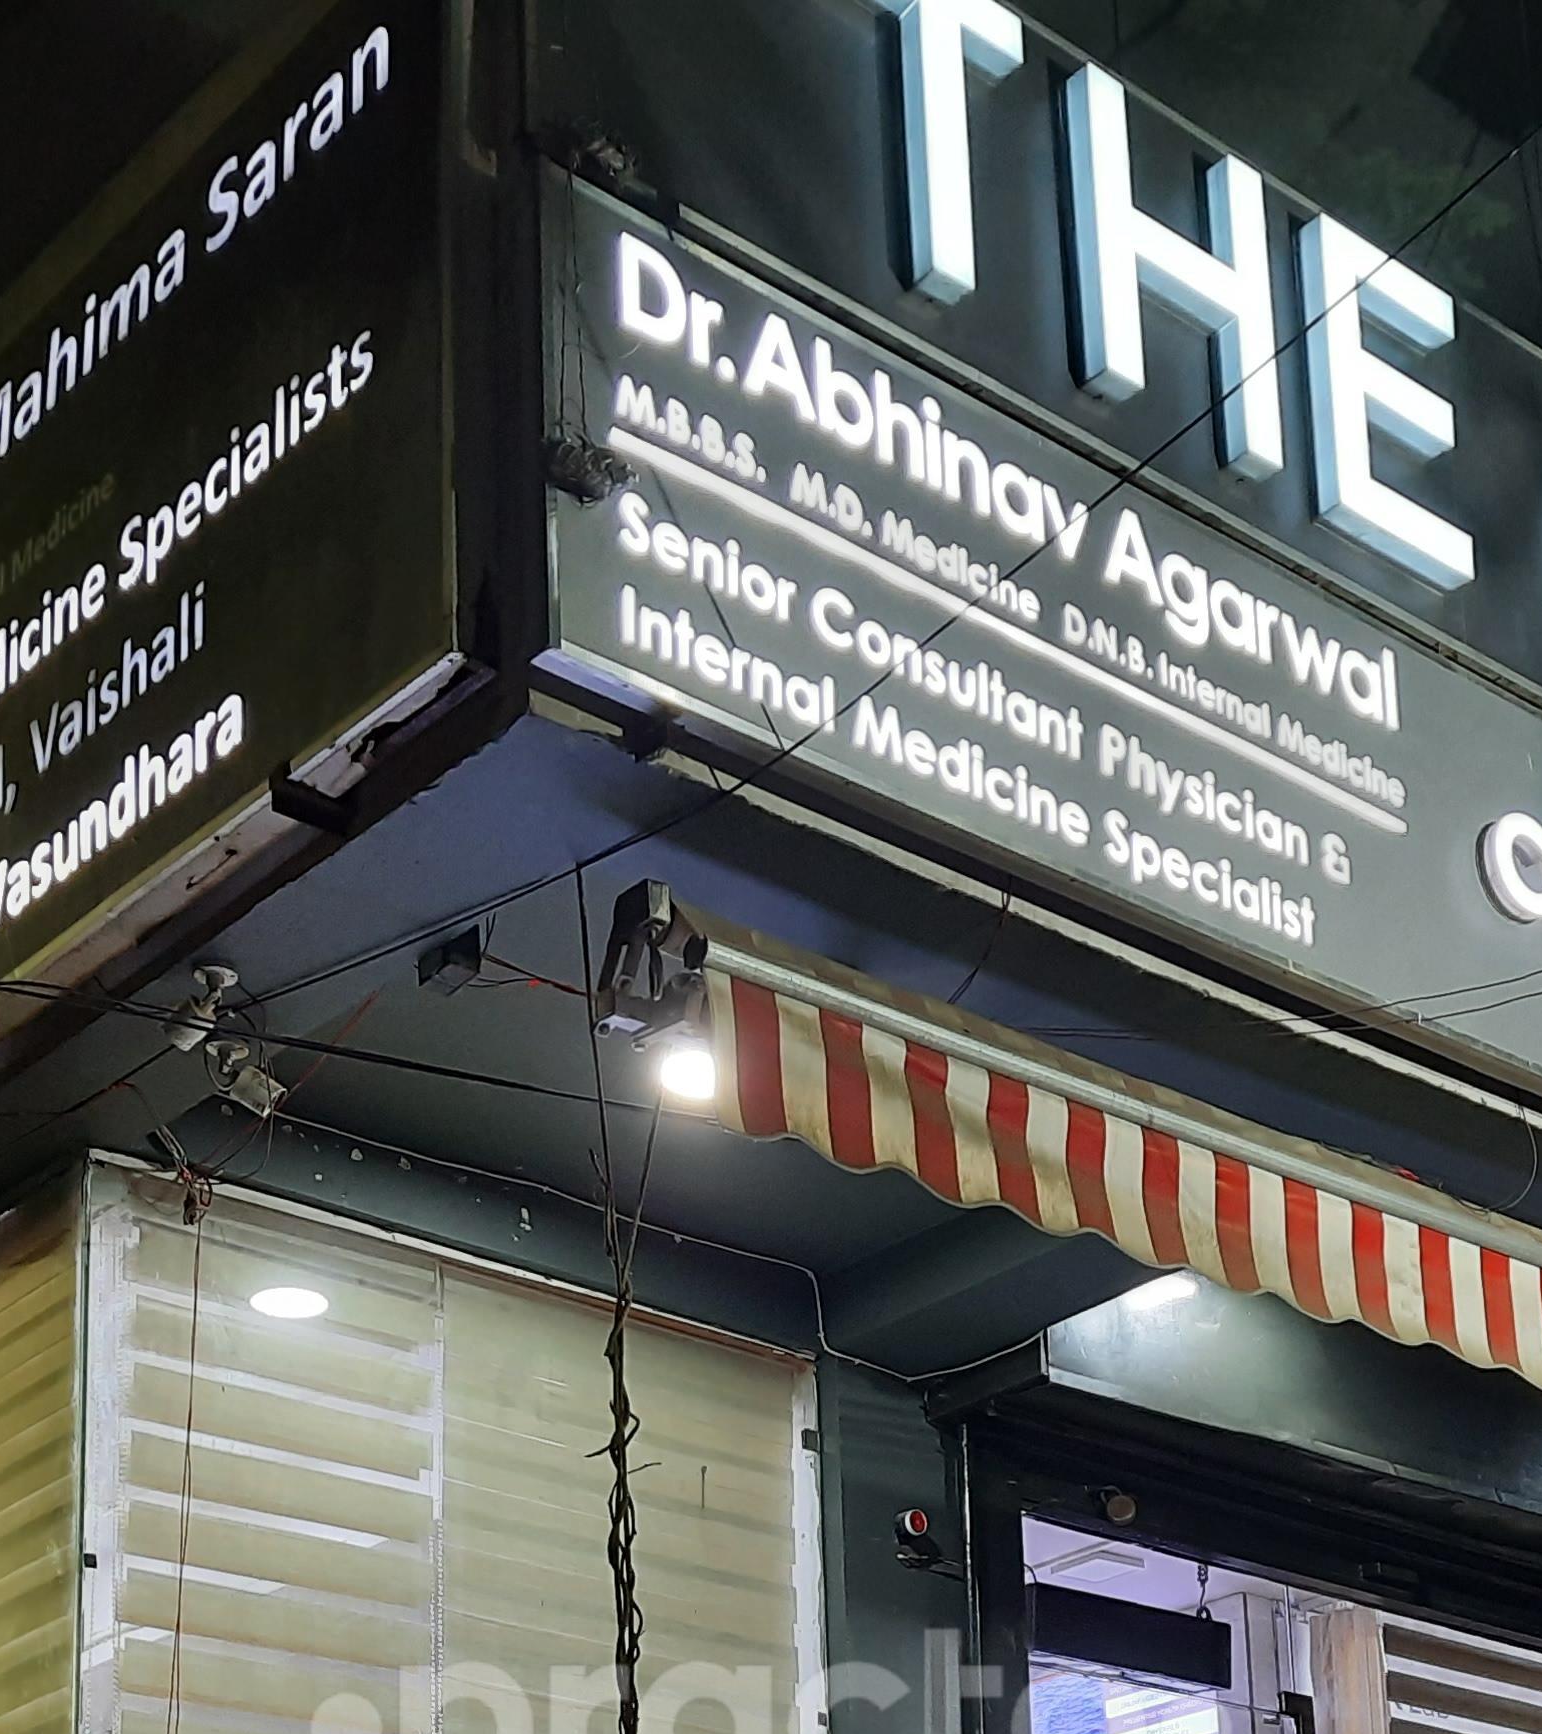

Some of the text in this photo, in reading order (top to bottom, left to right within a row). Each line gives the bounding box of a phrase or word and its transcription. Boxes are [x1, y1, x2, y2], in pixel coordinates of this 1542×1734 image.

[204, 24, 390, 254] Saran
[884, 0, 1476, 591] THE
[118, 328, 376, 589] Specialists
[29, 580, 207, 774] Vaishali
[618, 492, 1351, 886] Senior Consultant Physician &
[620, 584, 1315, 947] Internal Medicine Specialist
[790, 462, 873, 537] M.D.
[882, 510, 1041, 622] Medicine
[1159, 652, 1273, 738] Internal
[1277, 713, 1406, 807] Medicine
[1104, 508, 1402, 731] Agarwal
